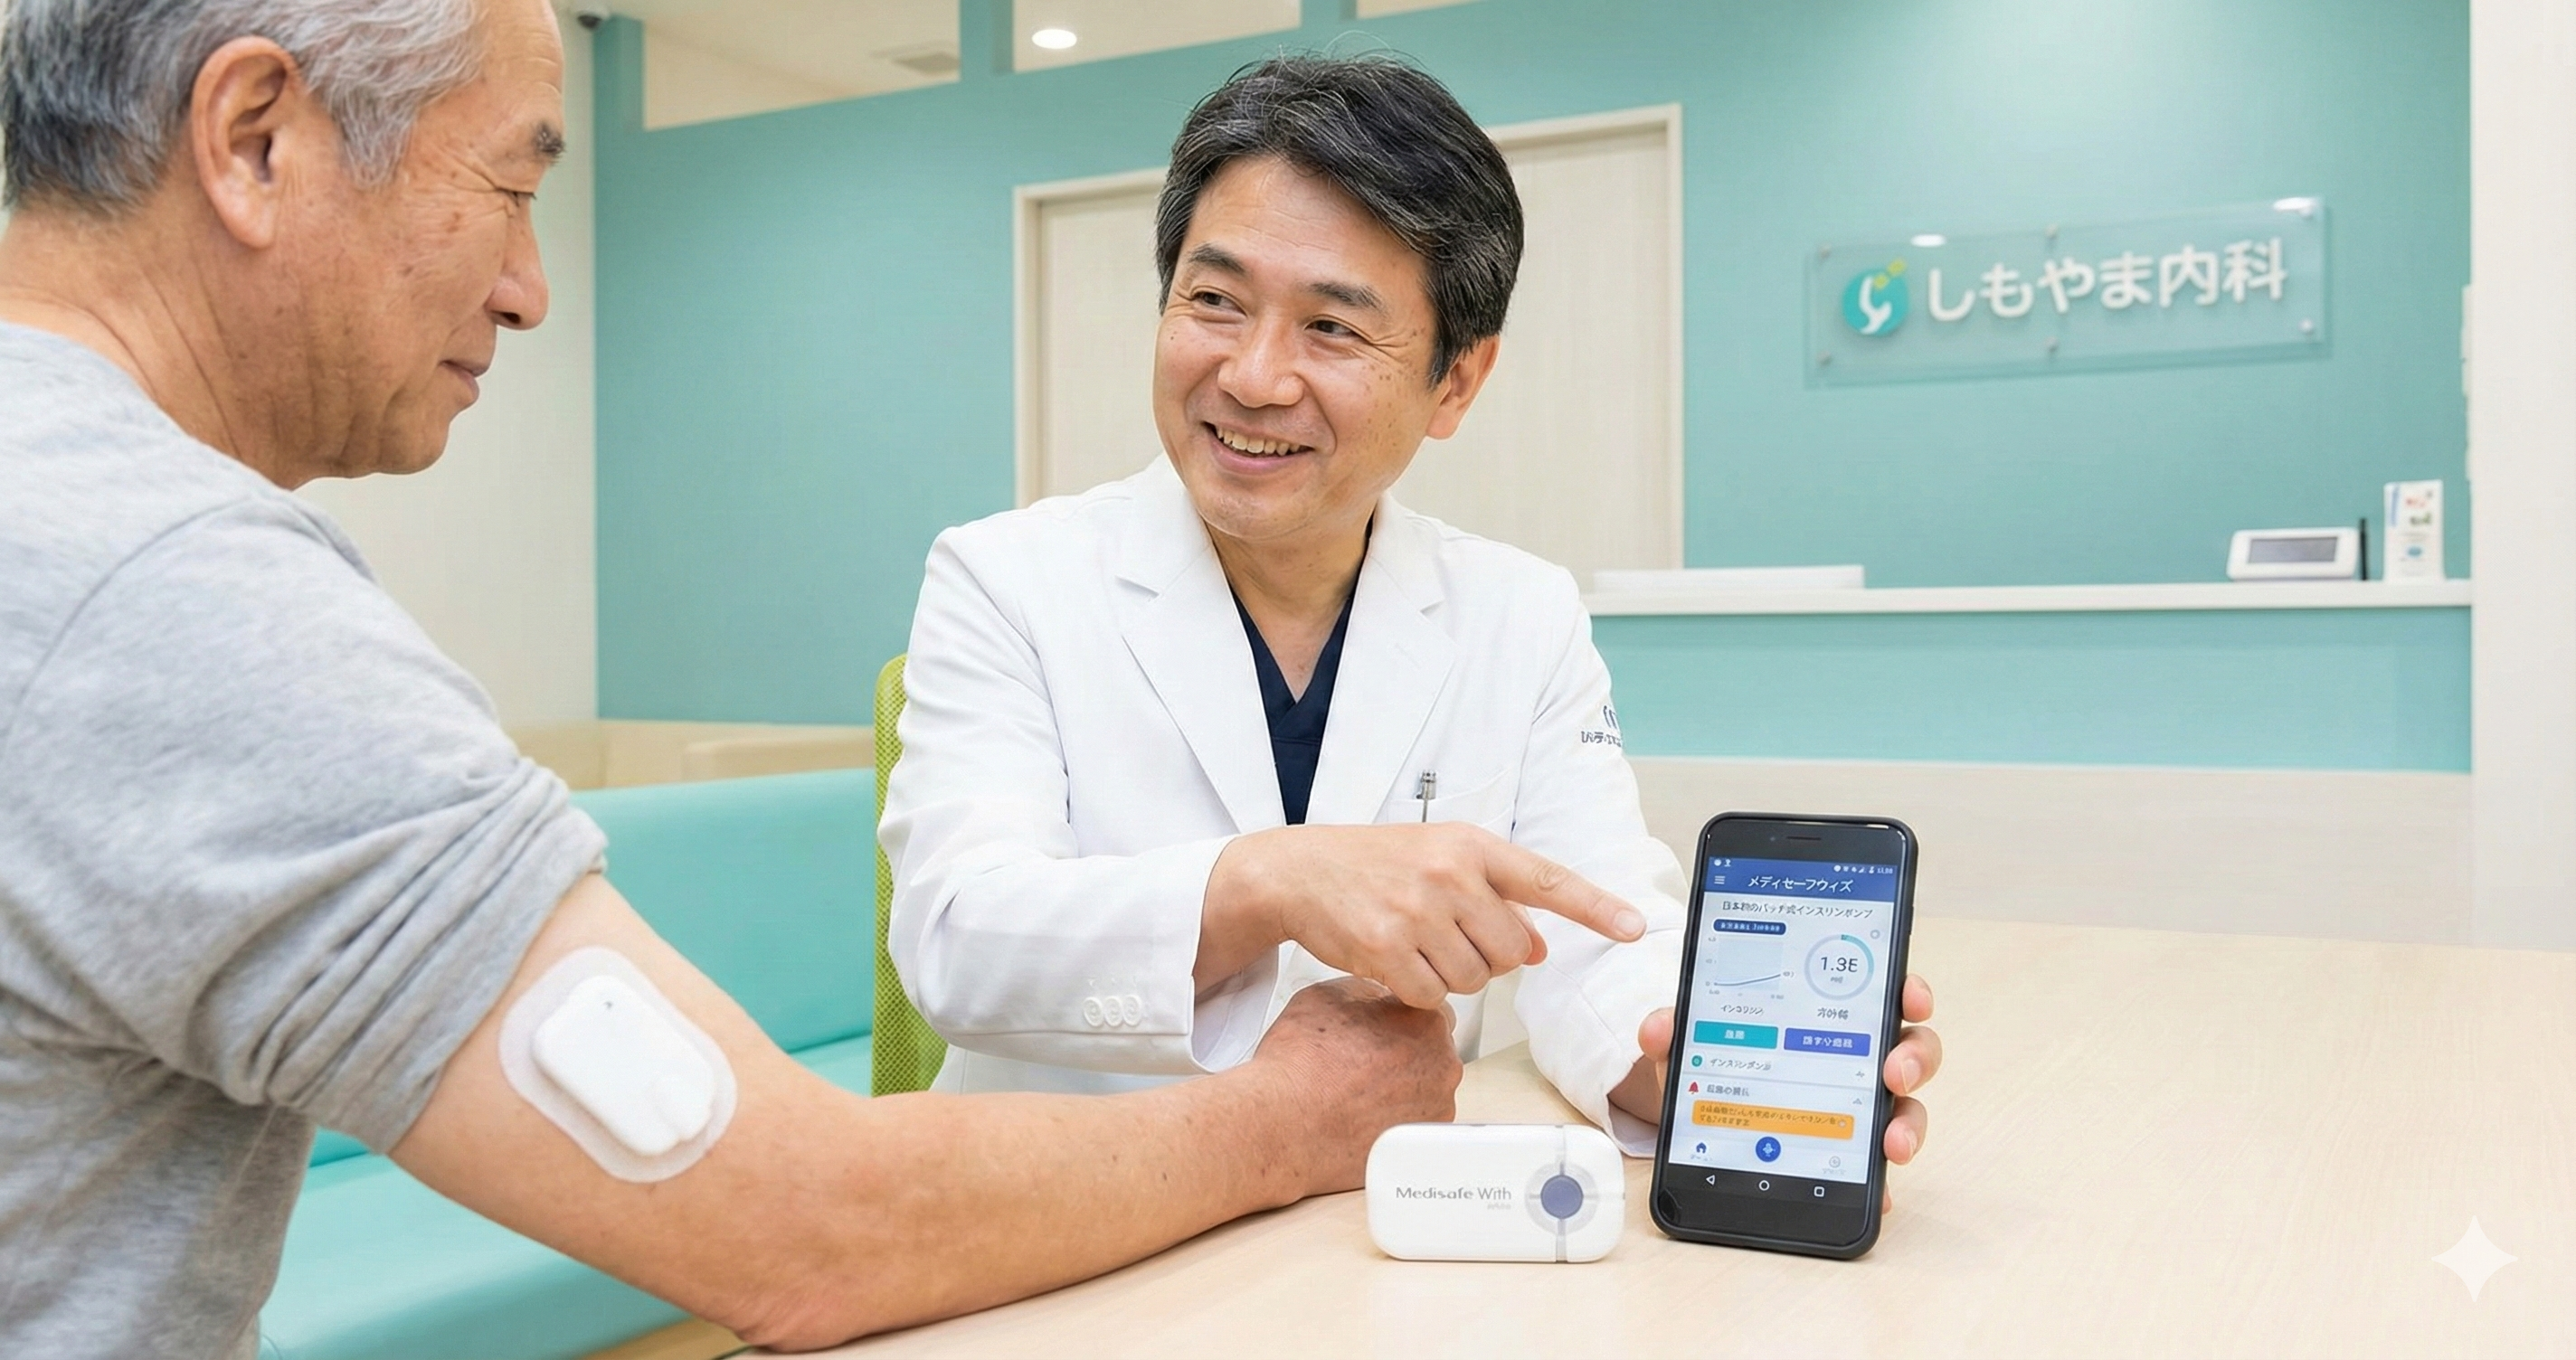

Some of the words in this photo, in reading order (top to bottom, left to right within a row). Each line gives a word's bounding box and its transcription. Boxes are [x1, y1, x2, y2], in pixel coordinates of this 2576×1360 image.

[1927, 237, 2288, 323] しもやま内科
[1747, 875, 1854, 893] メディセーフウィズ
[1396, 1186, 1474, 1200] Medisafe
[1477, 1186, 1511, 1200] With
